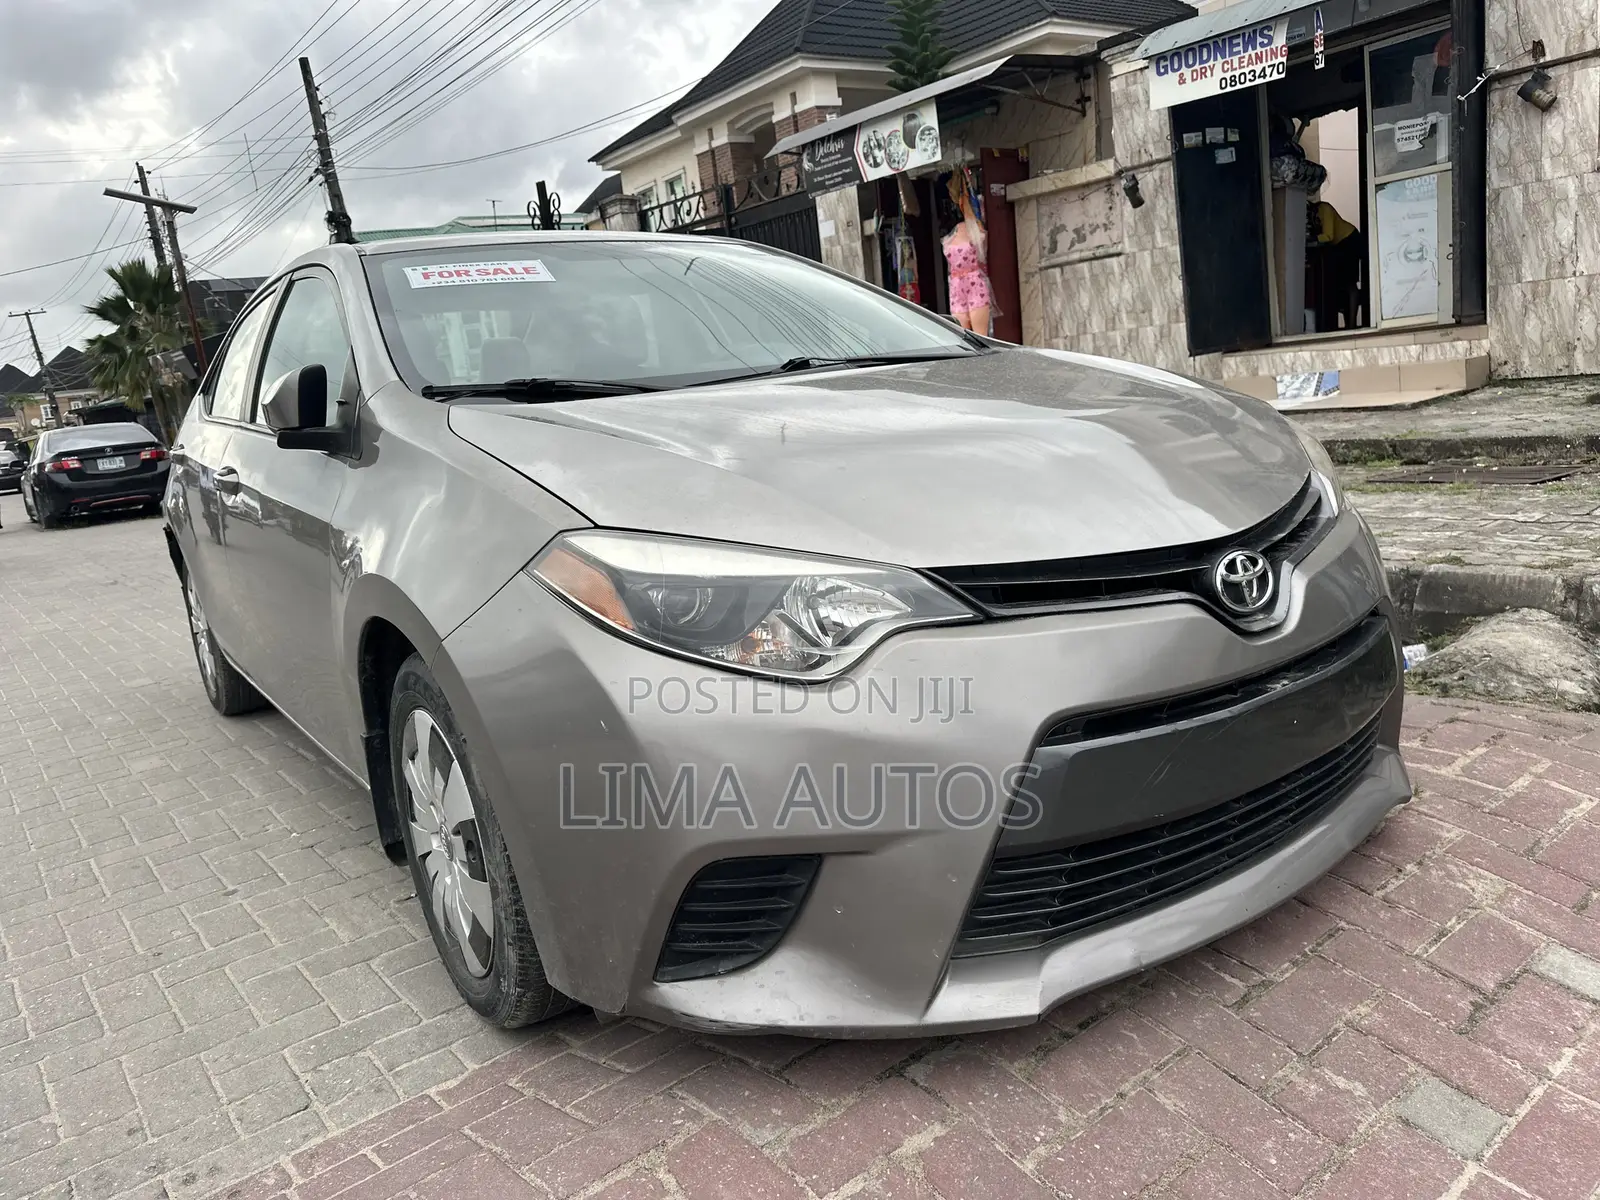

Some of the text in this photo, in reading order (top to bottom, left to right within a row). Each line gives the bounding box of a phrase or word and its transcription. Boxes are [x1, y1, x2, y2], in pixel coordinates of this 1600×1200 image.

[1155, 24, 1274, 77] GOODNEWS
[1177, 44, 1289, 86] & DRY CLEANING
[1314, 50, 1324, 66] 67
[1219, 61, 1286, 90] 0803470
[421, 266, 540, 280] FOR SALE
